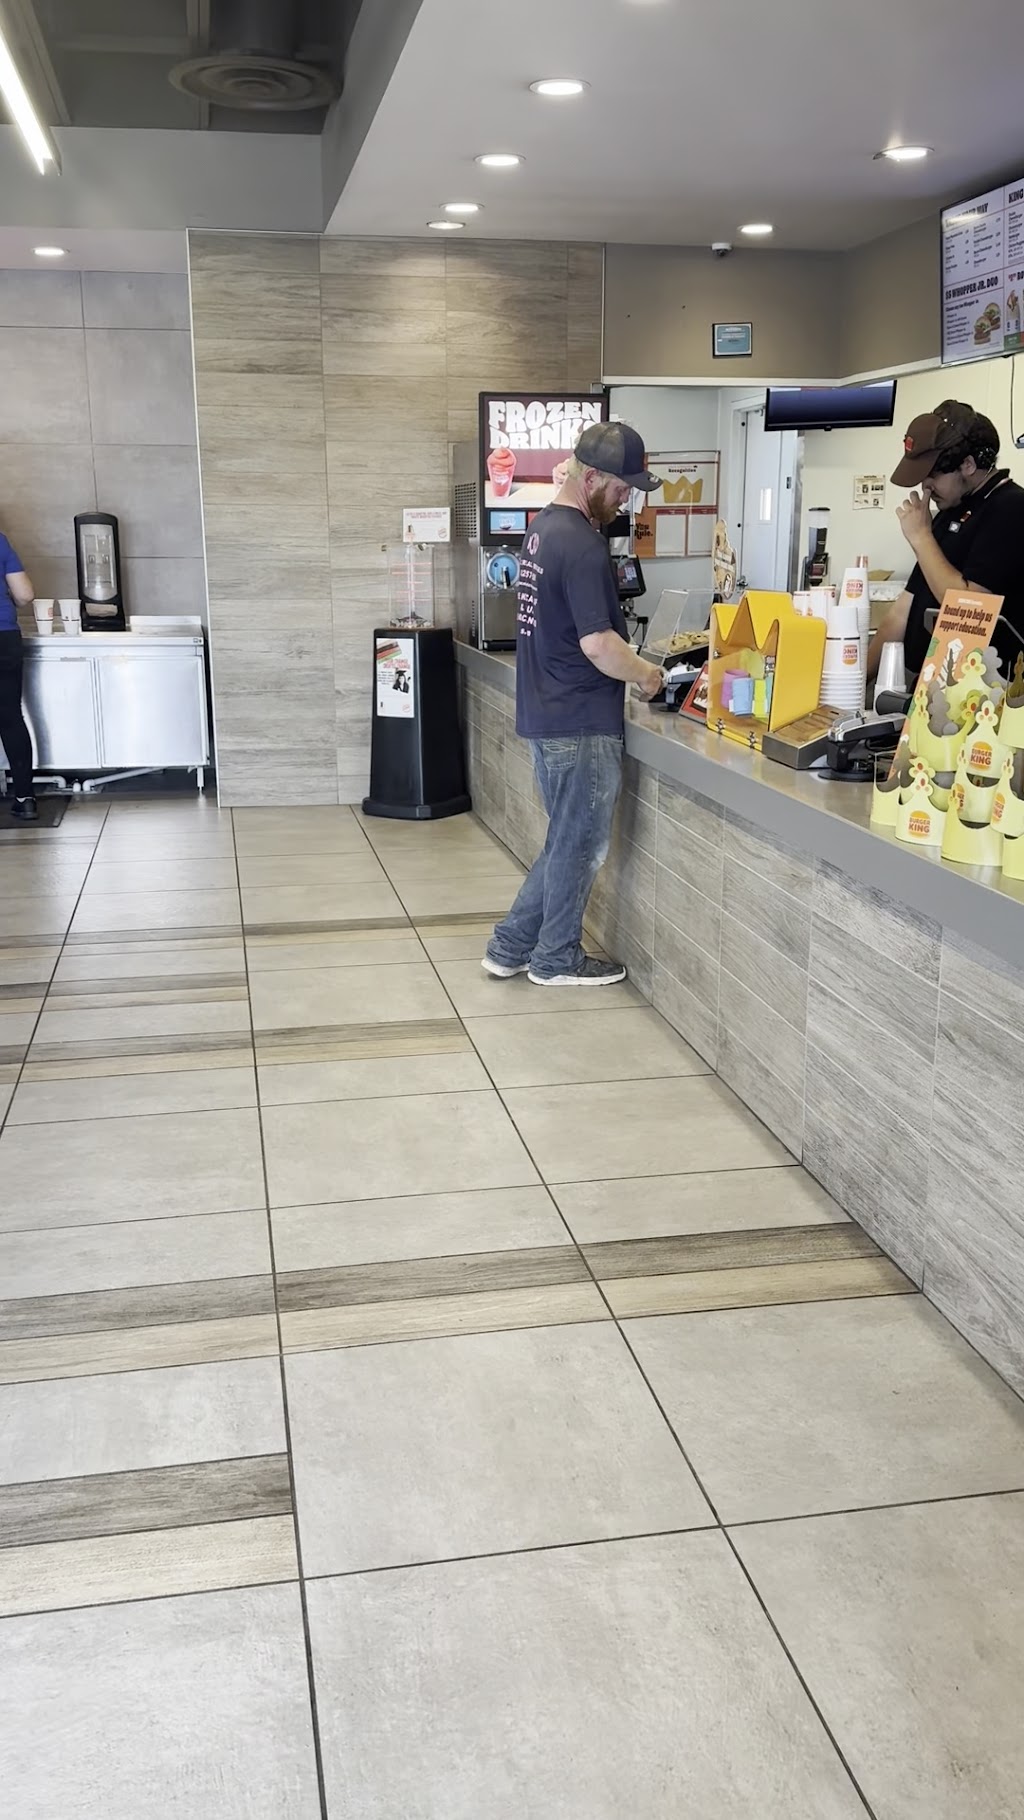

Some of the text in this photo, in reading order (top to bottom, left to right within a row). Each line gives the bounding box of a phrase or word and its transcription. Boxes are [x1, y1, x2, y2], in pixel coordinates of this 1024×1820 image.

[952, 282, 975, 298] WHOPPER
[987, 275, 998, 288] DUO
[488, 400, 602, 433] FROZEN
[489, 418, 597, 450] DRINK
[943, 604, 993, 626] Round up to help us
[939, 620, 987, 637] support education.
[971, 754, 991, 766] KING
[972, 748, 992, 757] BURGER
[908, 823, 930, 833] KING
[909, 816, 931, 826] BURGER
